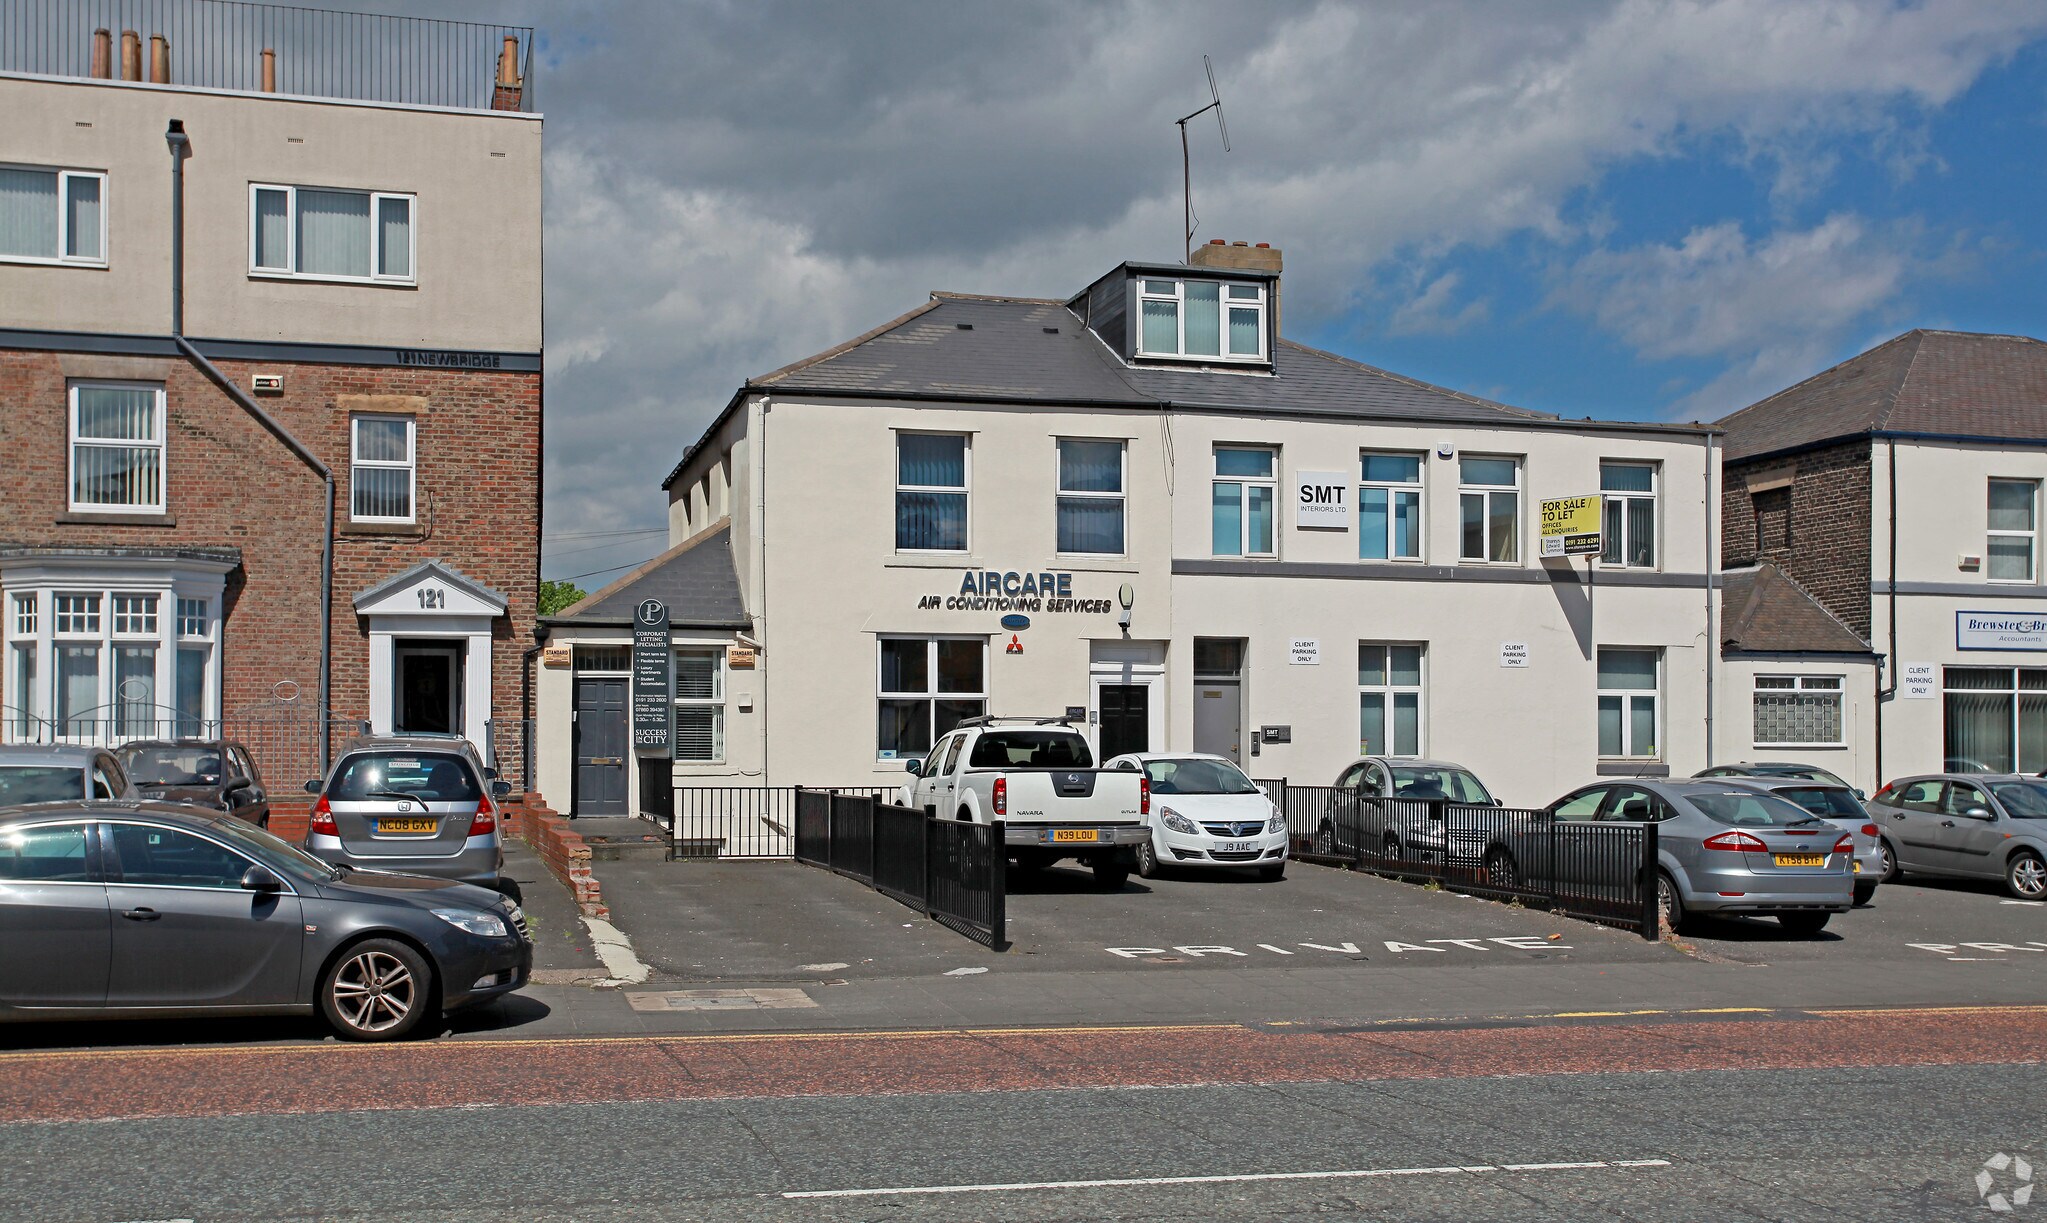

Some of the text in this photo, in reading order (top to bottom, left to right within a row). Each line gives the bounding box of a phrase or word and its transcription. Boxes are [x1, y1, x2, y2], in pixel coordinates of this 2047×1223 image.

[1300, 484, 1345, 503] SMT
[1542, 497, 1592, 511] FOR SALE /
[1541, 509, 1575, 521] TO LET
[1551, 526, 1578, 534] ENQUIRIES
[960, 571, 1073, 598] AIRCARE
[417, 588, 444, 609] 121
[918, 595, 1112, 614] AIR CONDITIONING SERVICES
[1968, 618, 2019, 630] Brewster
[1998, 635, 2042, 643] Accountants
[643, 735, 667, 744] CITY
[379, 819, 434, 830] NC08 GXV
[1057, 831, 1093, 840] N39 LOU
[1223, 843, 1234, 851] J9
[1779, 855, 1820, 865] KT58 BYF
[1105, 936, 1573, 957] PRIVATE
